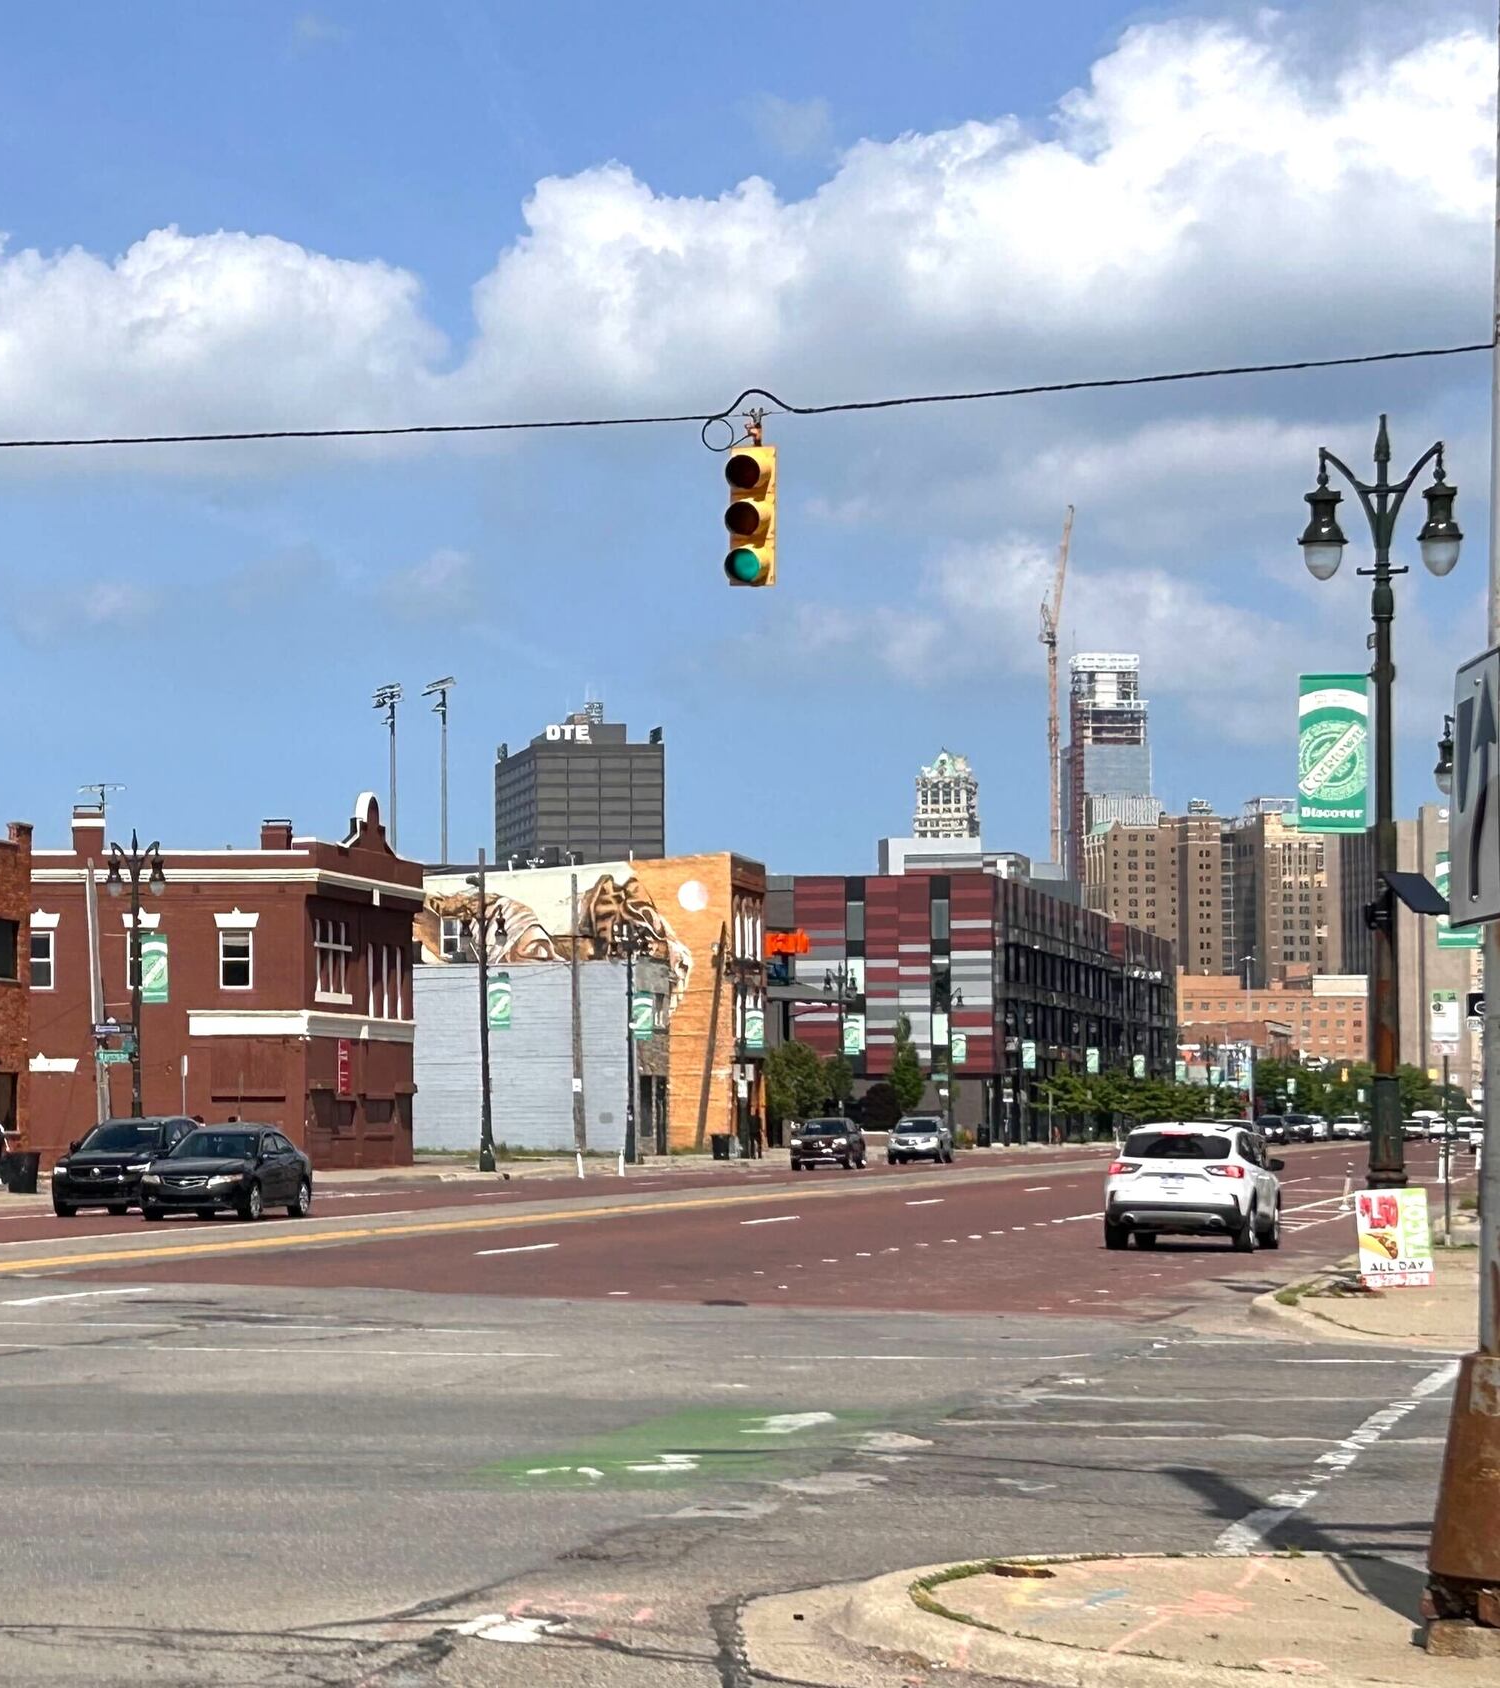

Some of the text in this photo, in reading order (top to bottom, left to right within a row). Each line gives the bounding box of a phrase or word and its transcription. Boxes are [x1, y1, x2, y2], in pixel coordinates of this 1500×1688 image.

[546, 724, 590, 741] DTE
[1301, 806, 1365, 819] Discover
[1370, 1261, 1425, 1272] ALL DAY
